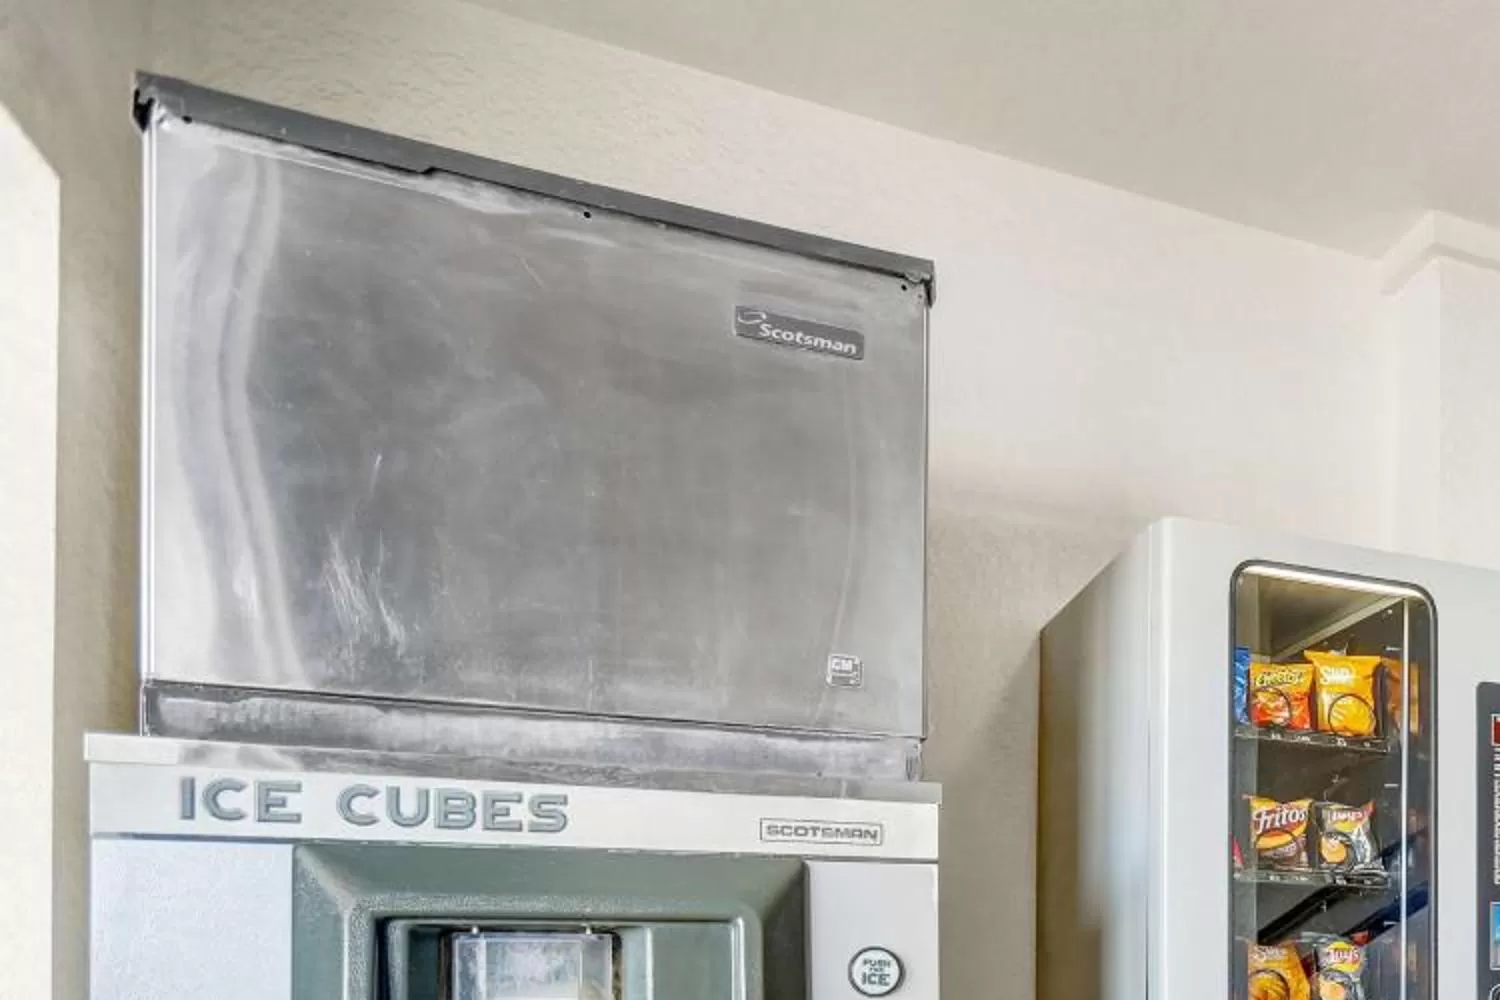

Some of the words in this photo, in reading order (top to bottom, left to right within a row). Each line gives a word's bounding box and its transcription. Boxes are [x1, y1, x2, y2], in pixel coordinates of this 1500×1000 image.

[759, 323, 857, 354] Scotsman
[179, 775, 303, 823] ICE
[336, 783, 570, 833] CUBES
[766, 824, 878, 839] SCOTSMAN
[862, 972, 891, 987] ICE
